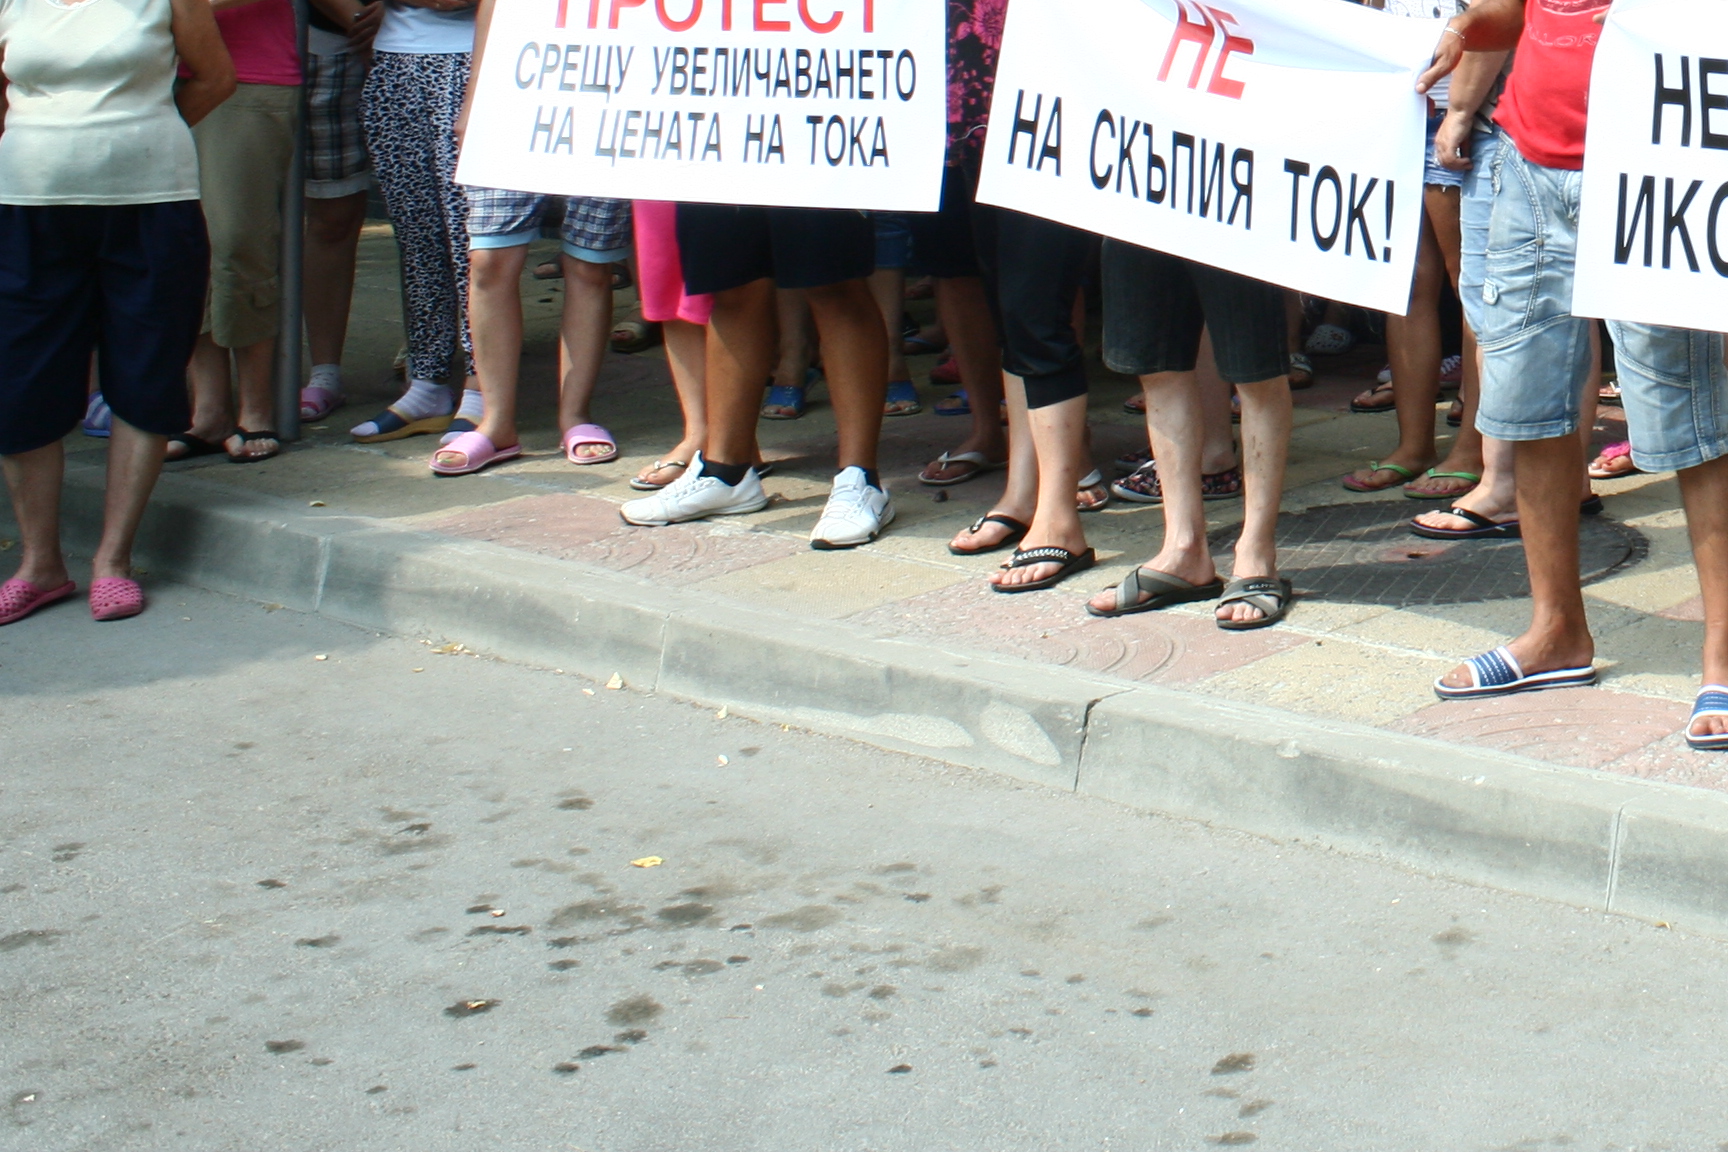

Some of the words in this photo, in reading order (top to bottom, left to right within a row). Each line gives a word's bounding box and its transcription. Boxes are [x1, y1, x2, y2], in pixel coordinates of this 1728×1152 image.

[515, 41, 635, 103] СРЕЩУ
[651, 45, 917, 102] УВЕЛИЧАВАНЕТО
[529, 105, 575, 155] НА
[594, 108, 723, 168] ЦЕНАТА
[742, 114, 785, 165] НА
[806, 114, 890, 168] ТОКА
[1007, 89, 1062, 177] НА
[1089, 107, 1255, 231] СКЪПИЯ
[1283, 157, 1395, 264] ТОК!
